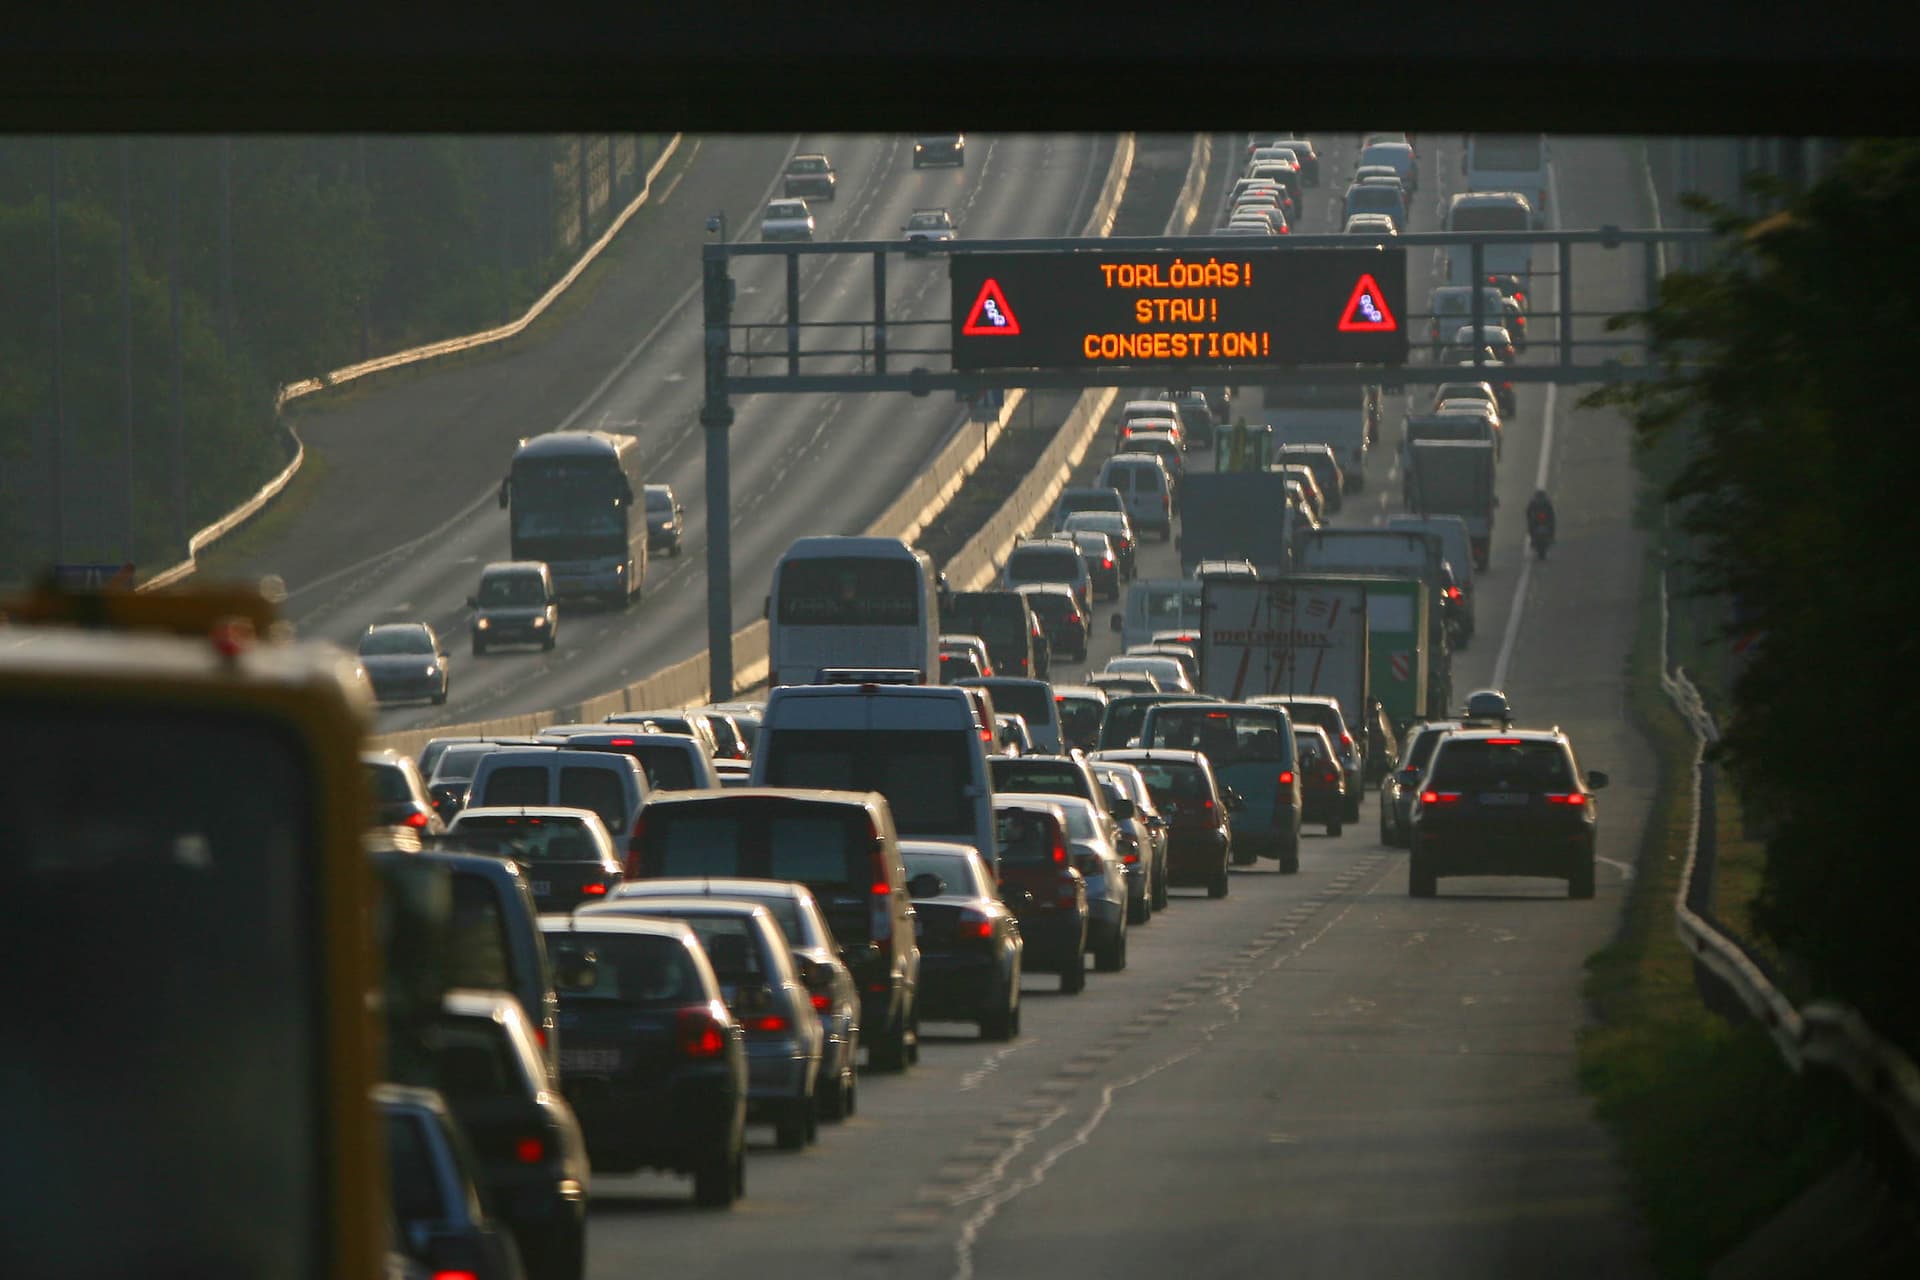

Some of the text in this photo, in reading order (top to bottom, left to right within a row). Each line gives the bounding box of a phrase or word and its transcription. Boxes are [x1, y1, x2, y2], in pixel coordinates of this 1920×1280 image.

[1101, 258, 1251, 287] TORLÓDÁS!
[1136, 298, 1217, 323] STAU!
[1083, 332, 1269, 359] CONGESTION!
